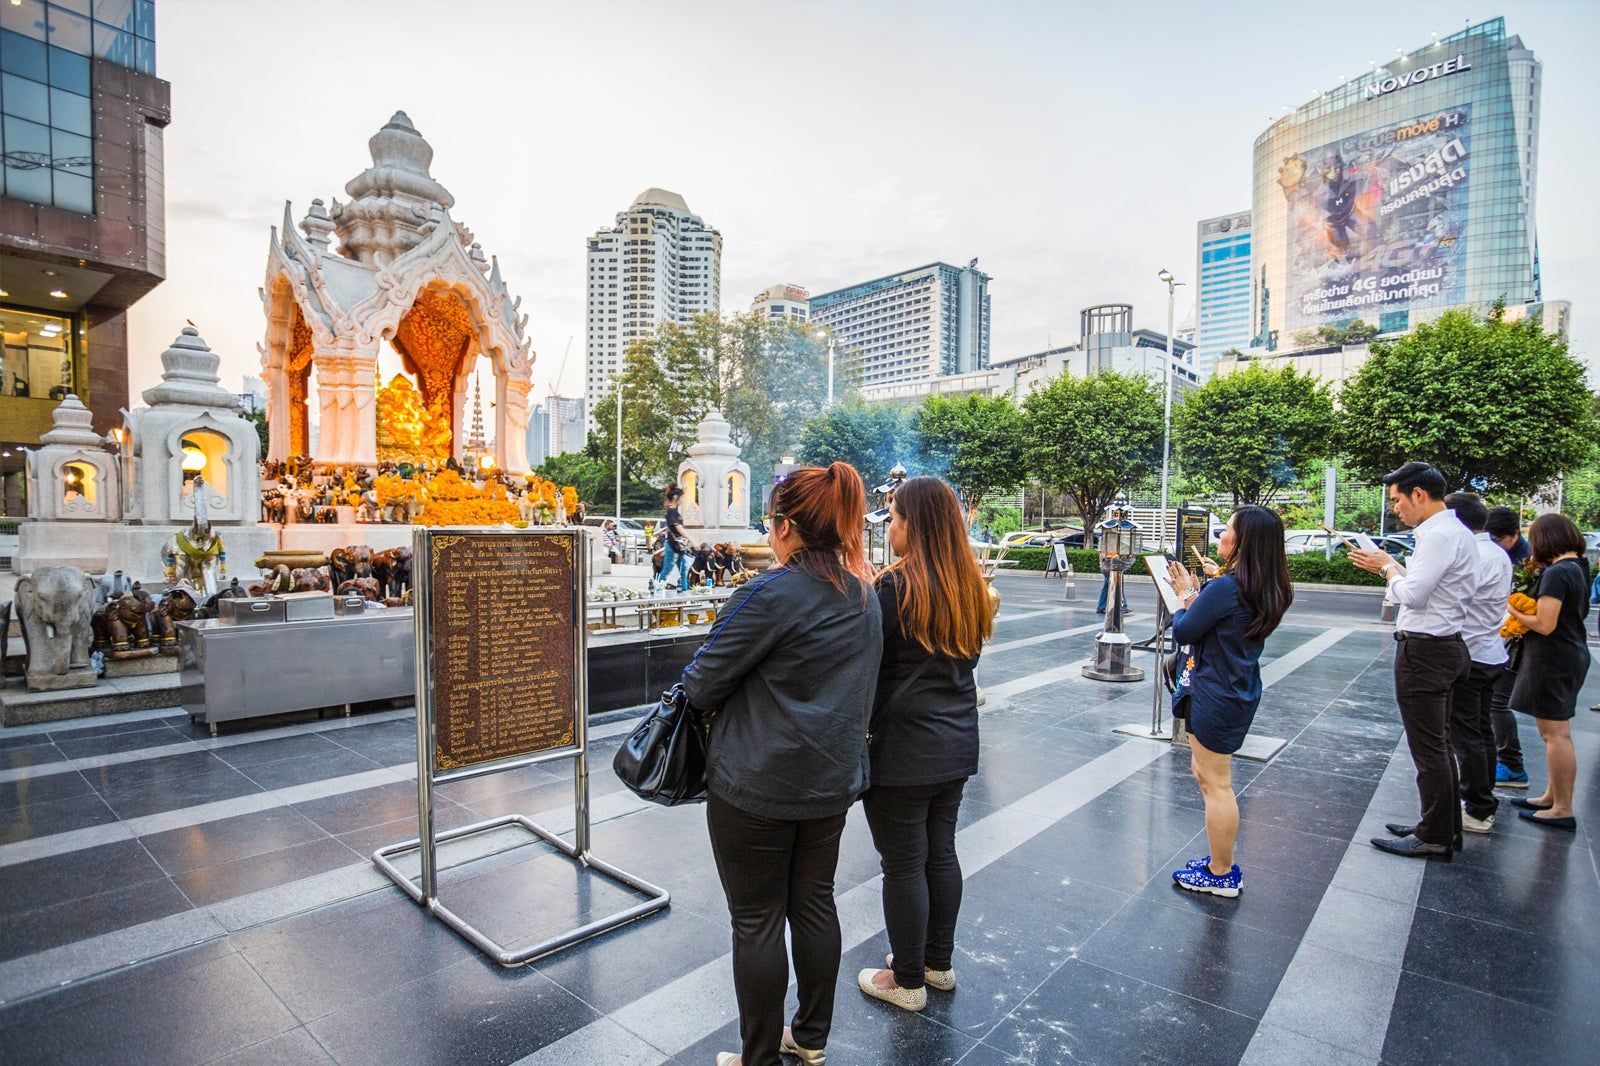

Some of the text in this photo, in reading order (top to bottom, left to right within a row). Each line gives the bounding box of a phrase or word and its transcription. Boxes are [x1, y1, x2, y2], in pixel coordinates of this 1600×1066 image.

[1363, 54, 1471, 101] NOVOTEL
[1389, 138, 1466, 196] แรงสุด
[1380, 167, 1466, 216] ครอบคลุมสุด
[1303, 266, 1443, 303] เครือข่าย 4G ยอดนิยม
